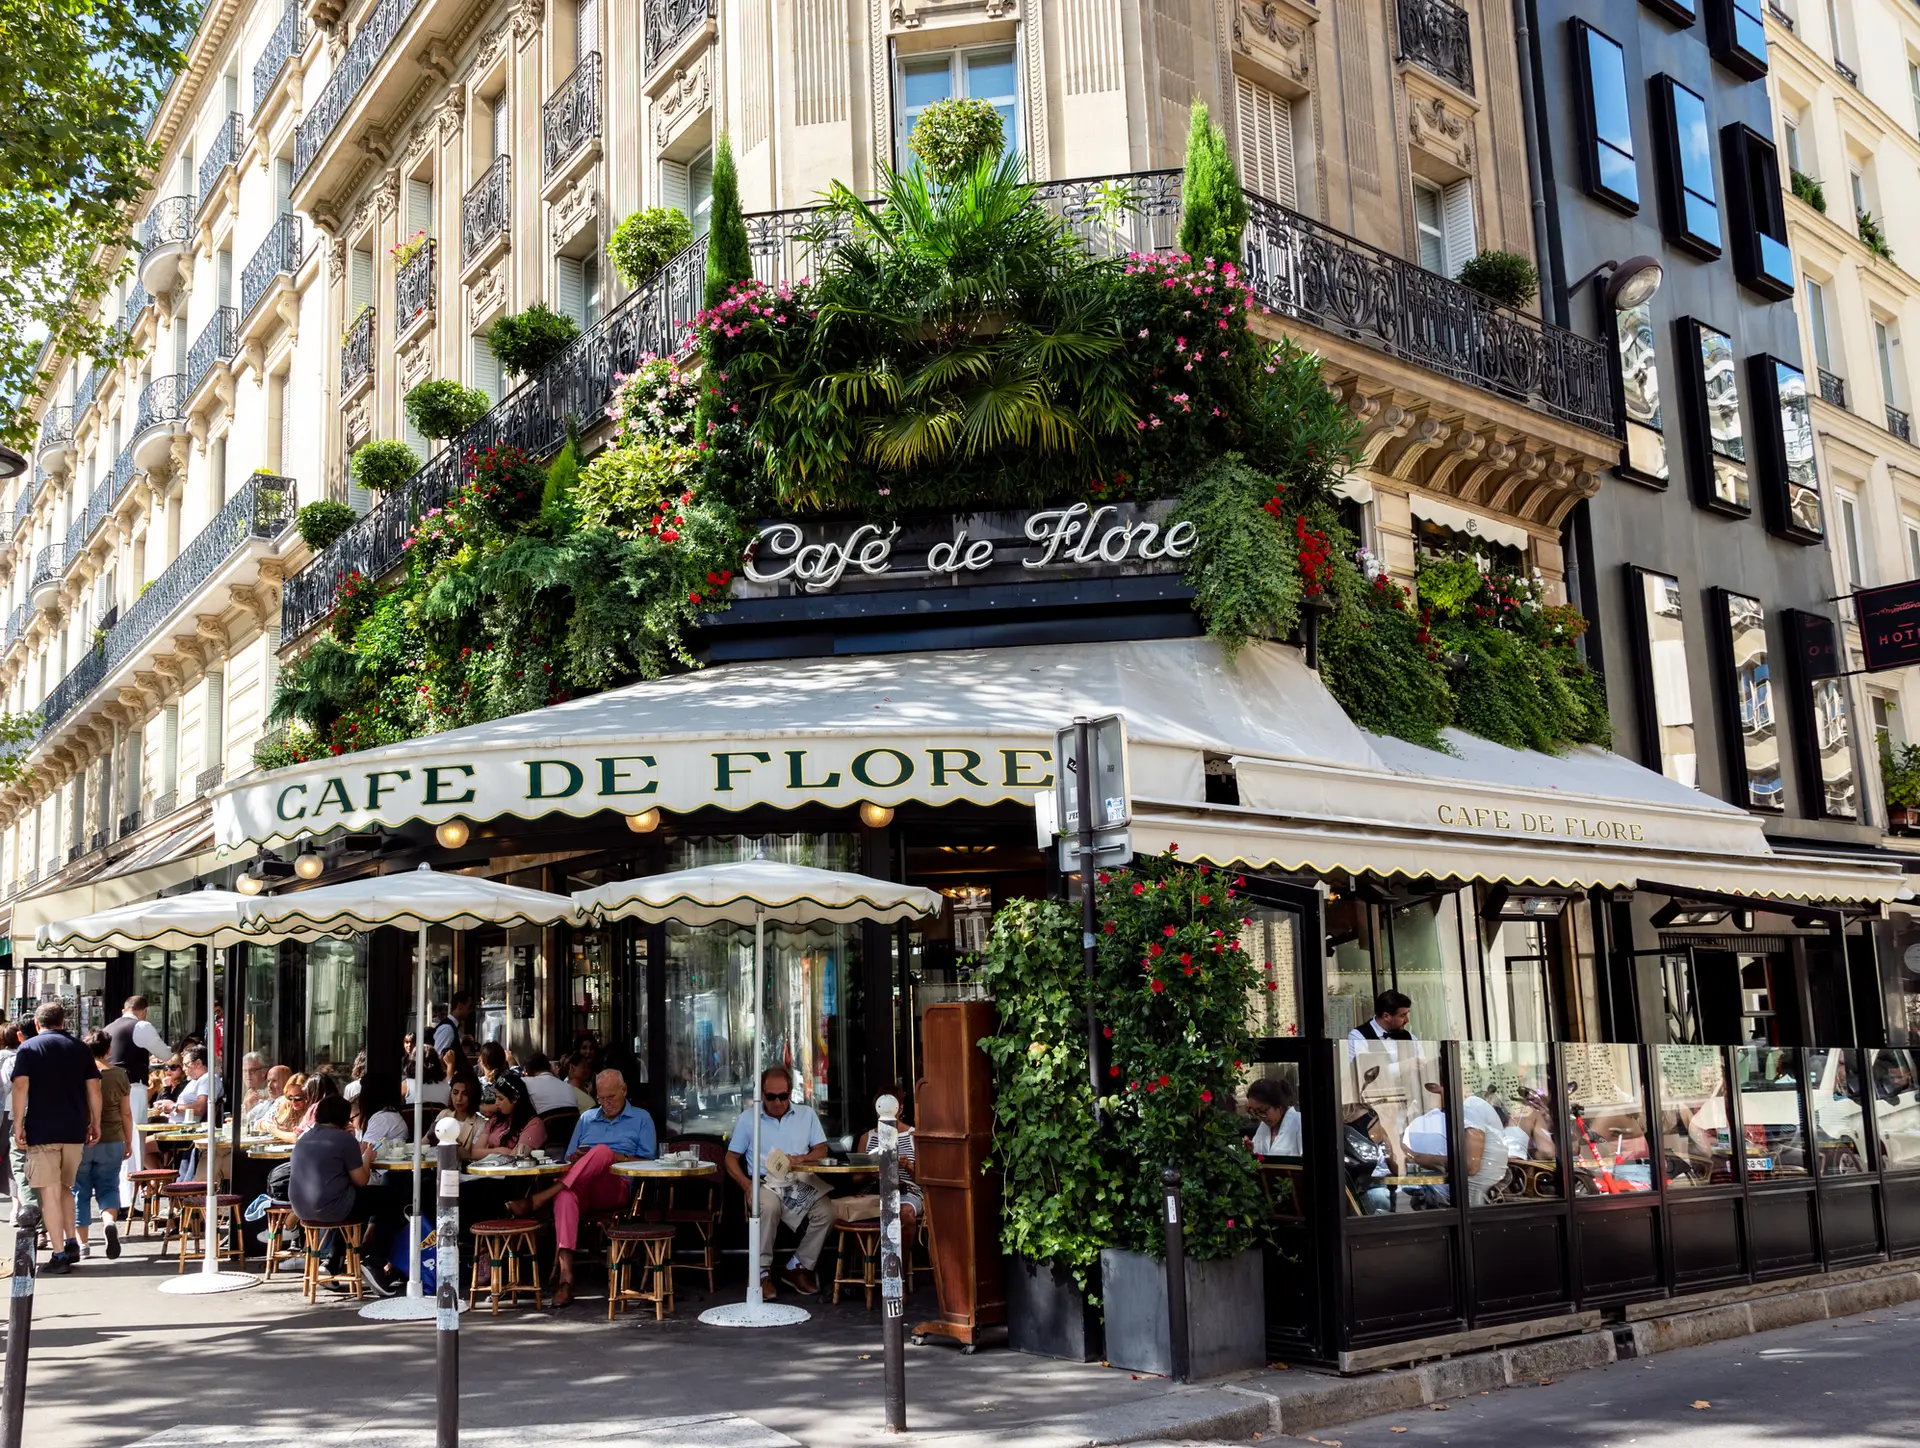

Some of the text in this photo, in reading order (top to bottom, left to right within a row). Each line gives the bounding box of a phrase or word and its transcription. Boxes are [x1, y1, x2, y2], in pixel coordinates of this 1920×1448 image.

[743, 502, 1200, 593] Café de Flore
[1879, 628, 1920, 646] HOT
[276, 747, 1055, 821] CAFE DE FLORE
[1437, 804, 1645, 842] CAFE DE FLORE
